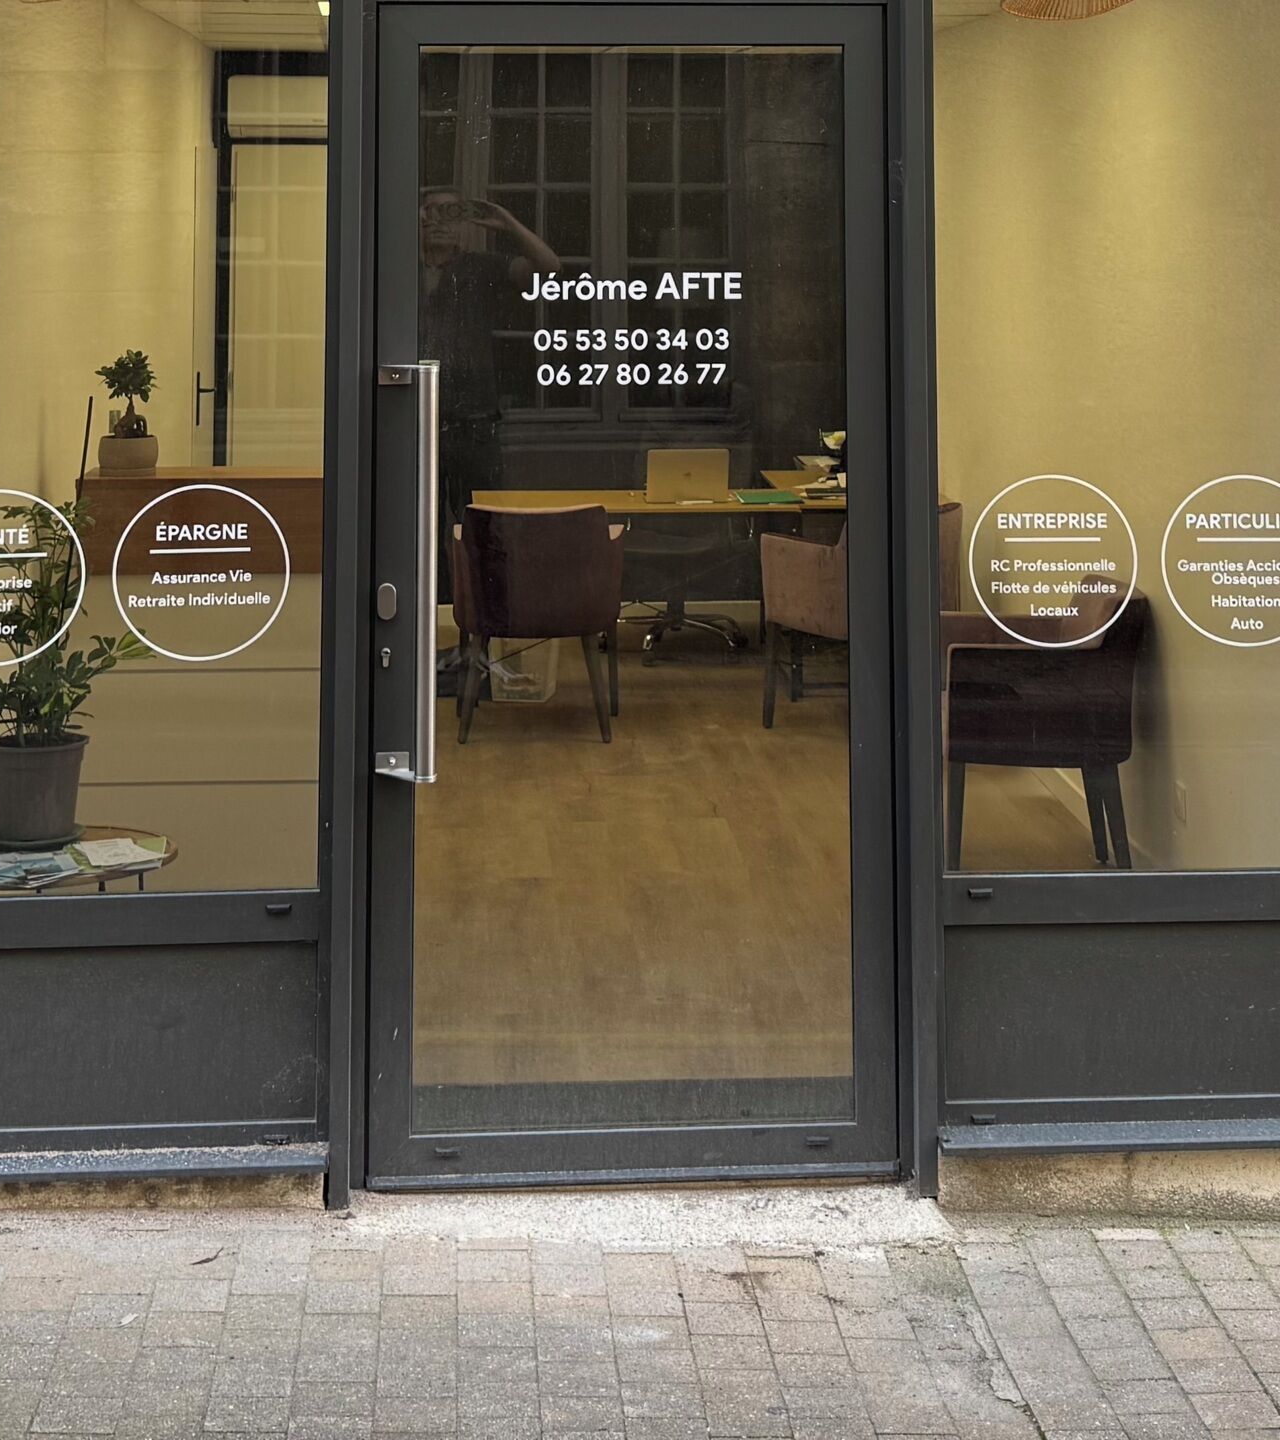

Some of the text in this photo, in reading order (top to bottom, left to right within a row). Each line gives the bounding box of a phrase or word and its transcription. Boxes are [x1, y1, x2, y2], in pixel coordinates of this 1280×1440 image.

[521, 272, 742, 301] Jérôme AFTE
[533, 328, 730, 351] 05 53 50 34 03
[536, 363, 727, 386] 06 27 80 26 77
[997, 513, 1107, 530] ENTREPRISE
[155, 521, 249, 542] ÉPARGNE
[990, 559, 1116, 573] RC Professionnelle
[1177, 559, 1244, 572] Garanties
[151, 569, 252, 586] Assurance Vie
[1211, 573, 1280, 587] Obsèques
[991, 580, 1117, 595] Flotte de véhicules
[128, 592, 271, 609] Retraite Individuelle
[1030, 604, 1079, 617] Locaux
[1230, 616, 1264, 631] Auto
